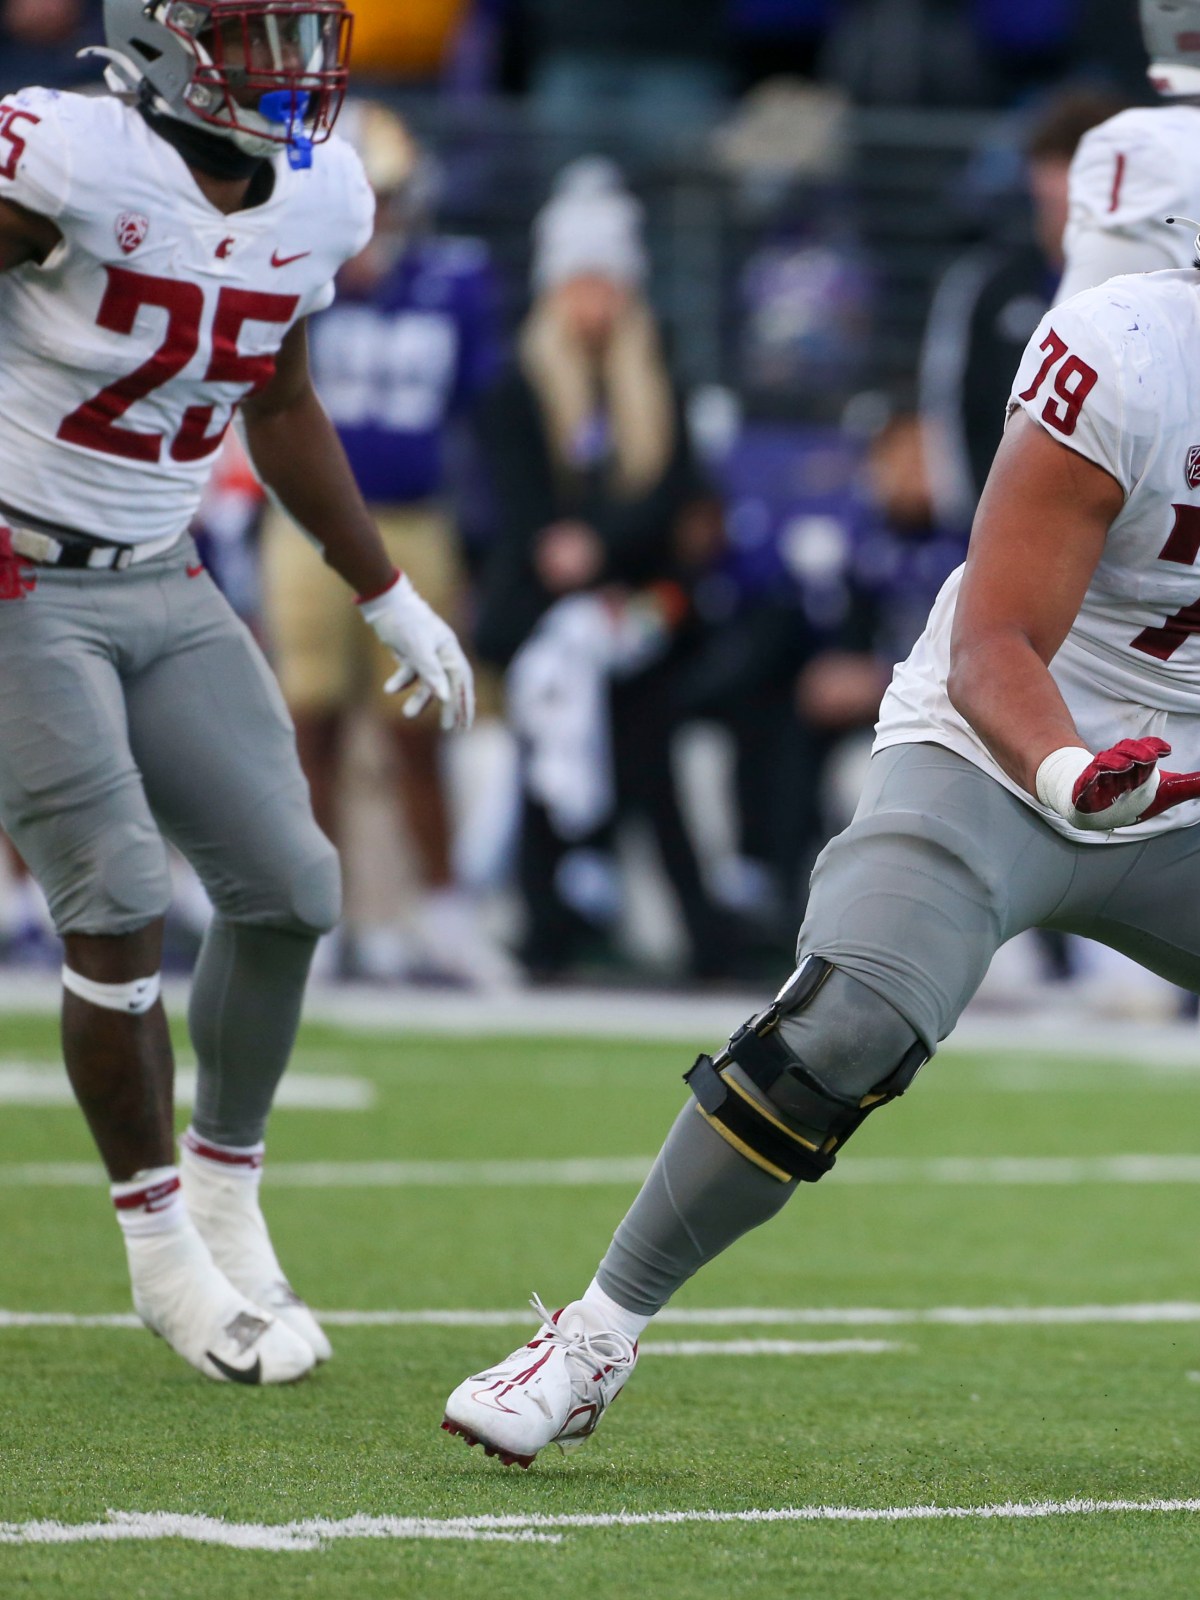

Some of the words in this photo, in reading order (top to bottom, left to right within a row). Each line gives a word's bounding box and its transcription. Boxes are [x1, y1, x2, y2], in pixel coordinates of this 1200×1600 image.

[0, 105, 41, 181] 5
[56, 264, 300, 463] 25
[1018, 326, 1098, 436] 79
